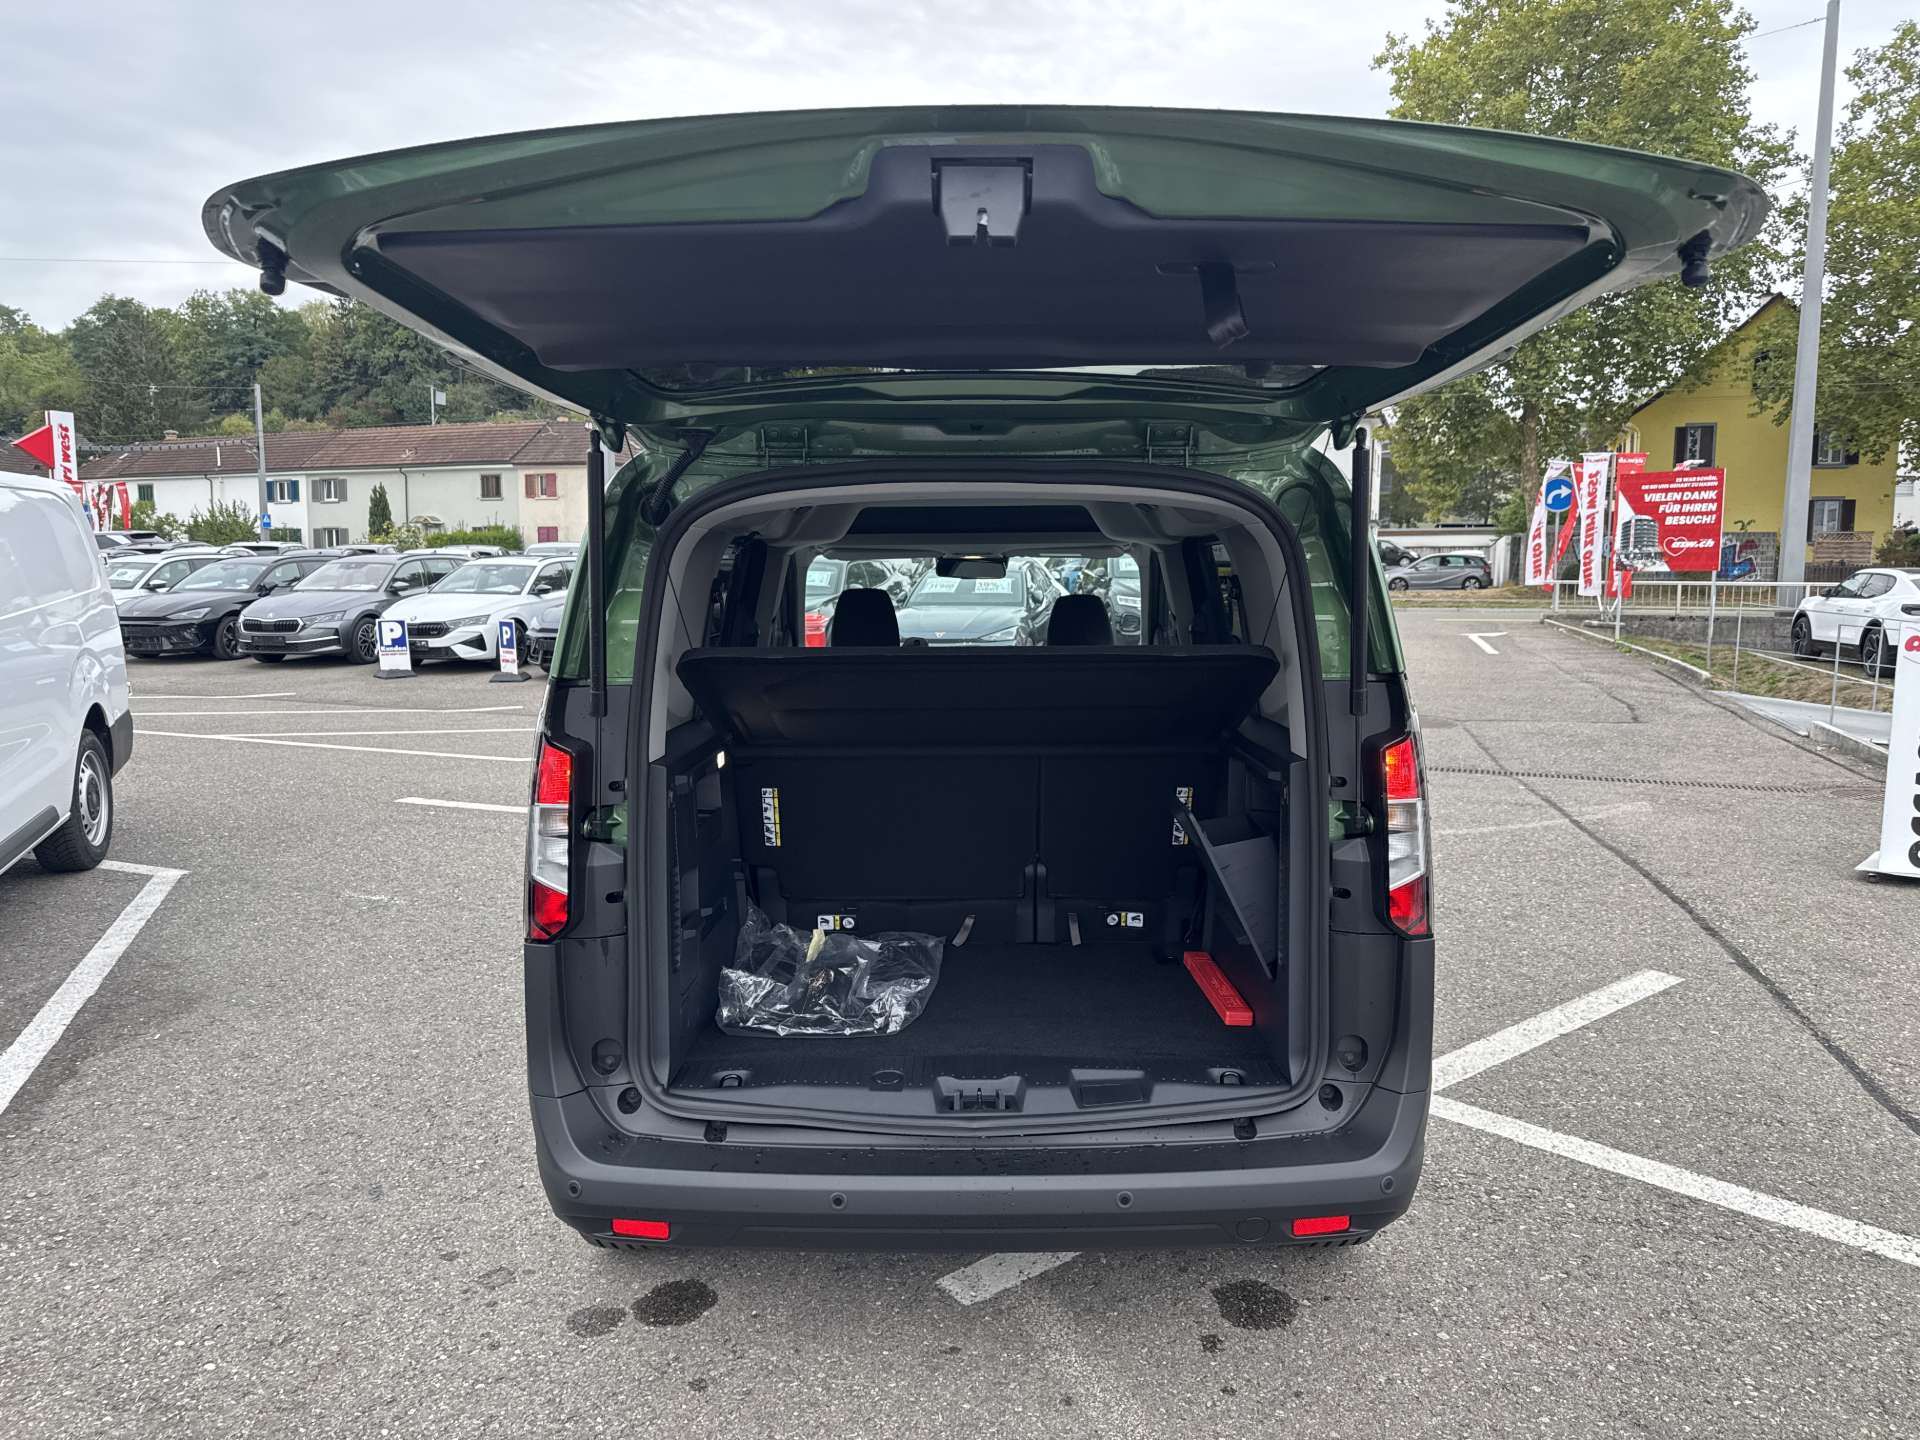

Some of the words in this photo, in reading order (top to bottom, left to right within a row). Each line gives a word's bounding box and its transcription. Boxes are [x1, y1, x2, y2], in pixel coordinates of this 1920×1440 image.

[59, 423, 72, 463] west
[1644, 493, 1681, 502] VIELEN
[1683, 490, 1717, 500] DANK
[1658, 502, 1681, 513] FÜR
[1682, 502, 1717, 512] IHREN
[1665, 515, 1715, 526] BESUCH!
[381, 622, 402, 646] P
[502, 625, 511, 646] P
